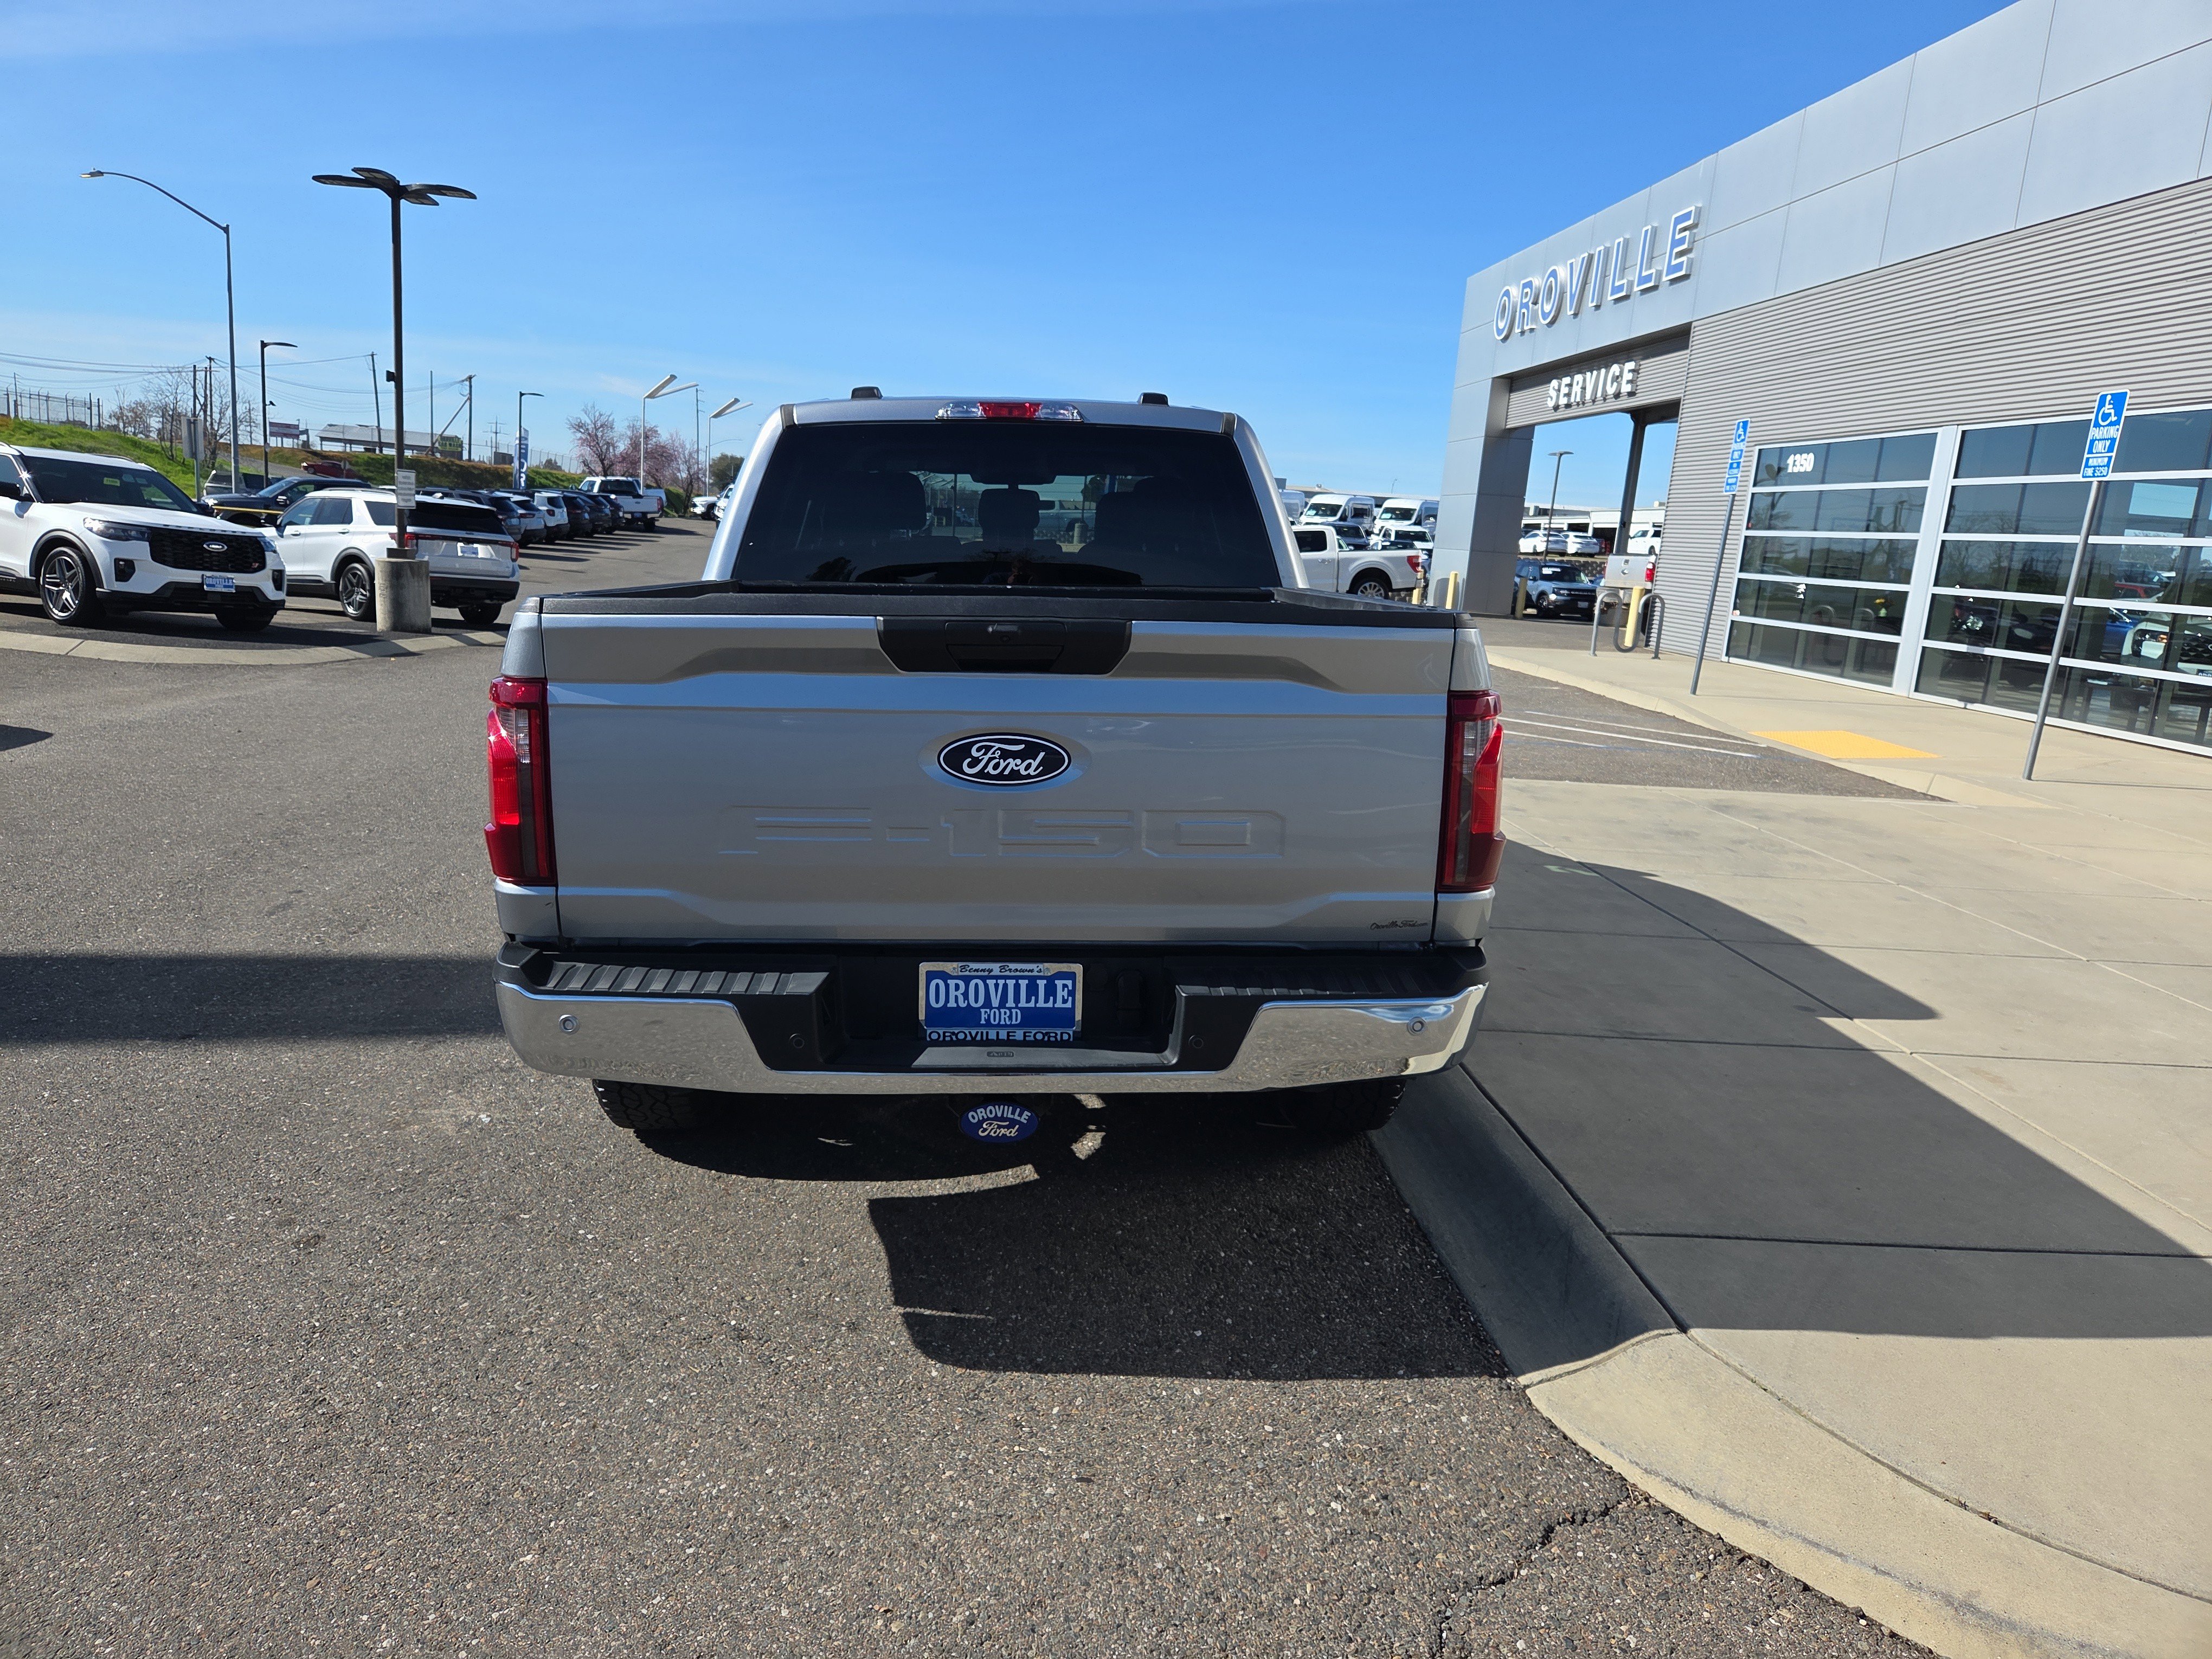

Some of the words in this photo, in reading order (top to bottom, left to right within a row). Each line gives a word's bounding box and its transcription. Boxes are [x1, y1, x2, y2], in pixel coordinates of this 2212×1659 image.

[1494, 205, 1699, 340] OROVILLE
[1547, 361, 1637, 408] SERVICE
[2090, 425, 2120, 440] PARKING
[2093, 440, 2111, 453] ONLY
[1786, 452, 1815, 473] 1350
[205, 577, 233, 586] OROVILLE
[962, 742, 1046, 776] Ford
[718, 805, 1287, 858] F-150
[959, 964, 994, 975] Benny
[999, 964, 1043, 974] Brown's
[929, 979, 1072, 1008] OROVILLE
[980, 1008, 1021, 1025] FORD
[928, 1030, 1017, 1041] OROVILLE
[1023, 1031, 1072, 1041] FORD
[968, 1105, 1031, 1123] OROVILLE
[978, 1120, 1019, 1137] Ford
